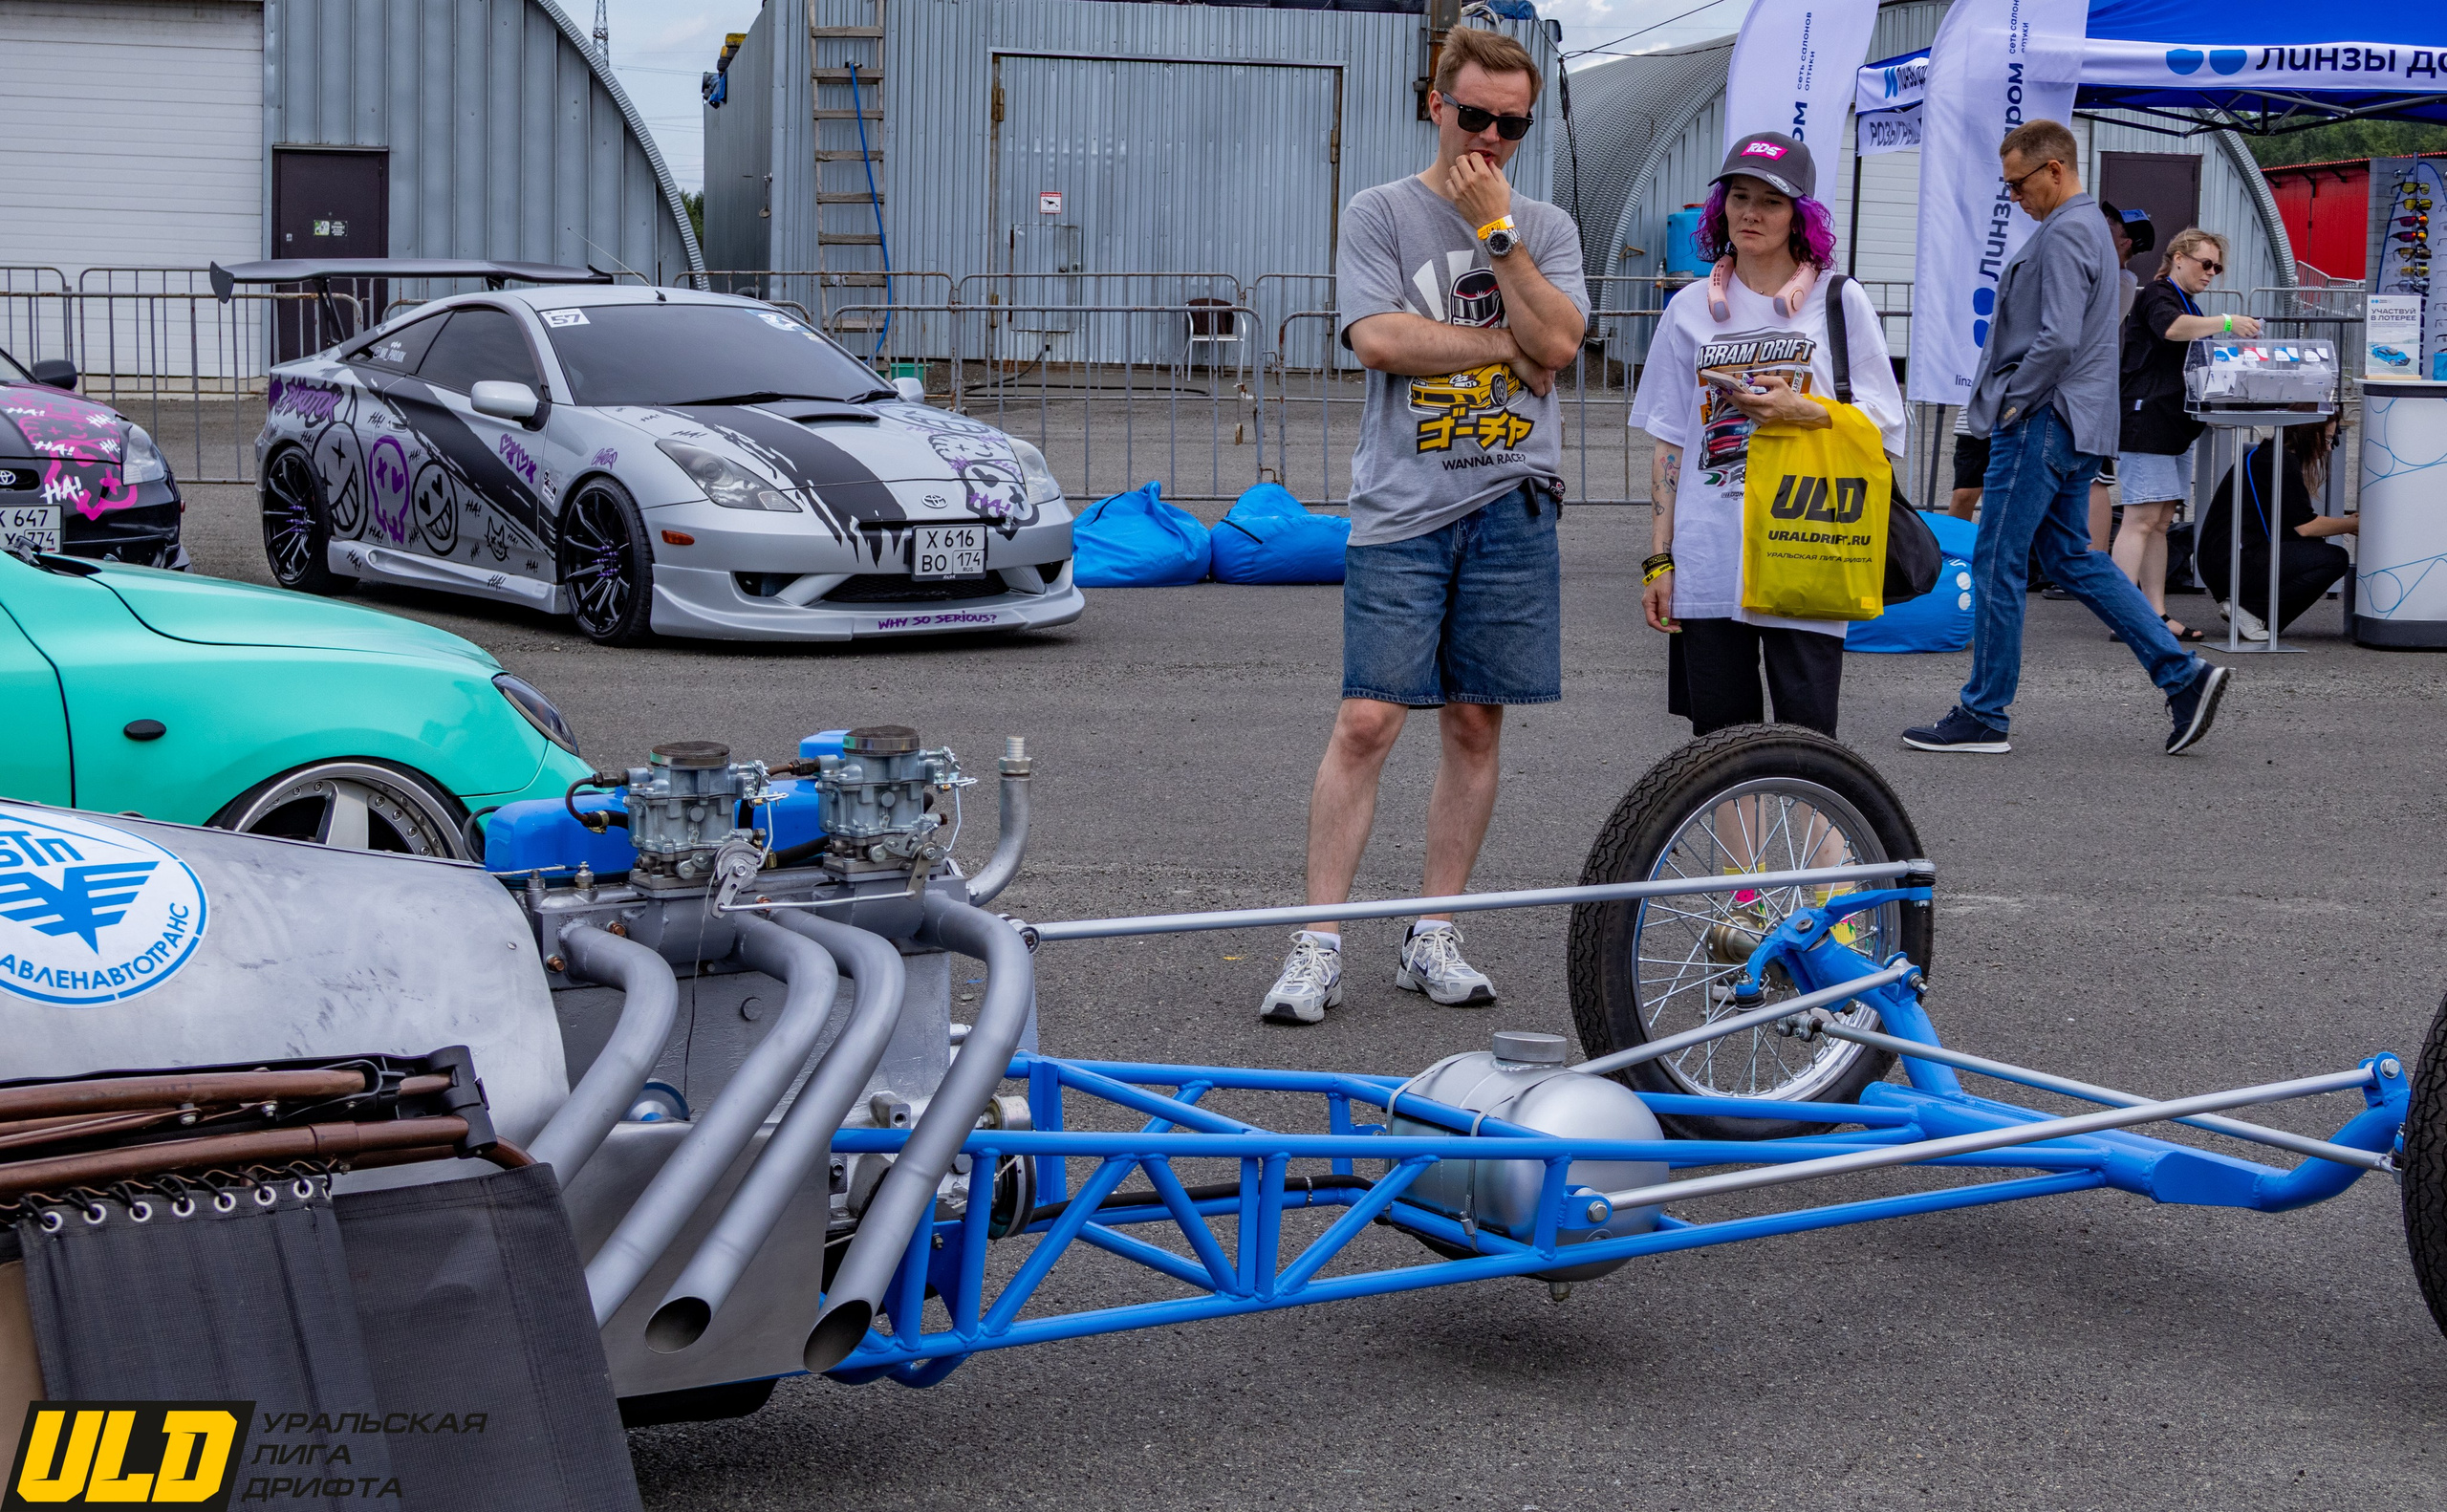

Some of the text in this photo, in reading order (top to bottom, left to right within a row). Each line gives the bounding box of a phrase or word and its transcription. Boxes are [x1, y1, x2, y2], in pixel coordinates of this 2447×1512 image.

[1801, 11, 1812, 61] салонов
[1805, 51, 1815, 91] оптики
[1746, 142, 1783, 158] RDS
[550, 313, 581, 325] 57
[1696, 337, 1817, 371] ABRAM DRIFT
[1418, 405, 1534, 453] ゴーチャ
[1442, 453, 1527, 471] WANNA RACE?
[40, 476, 85, 505] HA!
[1770, 474, 1869, 524] ULD
[465, 499, 482, 518] HA!
[13, 509, 49, 528] 647
[944, 529, 975, 548] 616
[1767, 529, 1872, 547] URALDRIFT.RU
[957, 551, 981, 567] 174
[1766, 551, 1818, 561] УРАЛЬСКАЯ
[877, 617, 908, 630] WHY
[912, 616, 931, 626] SO
